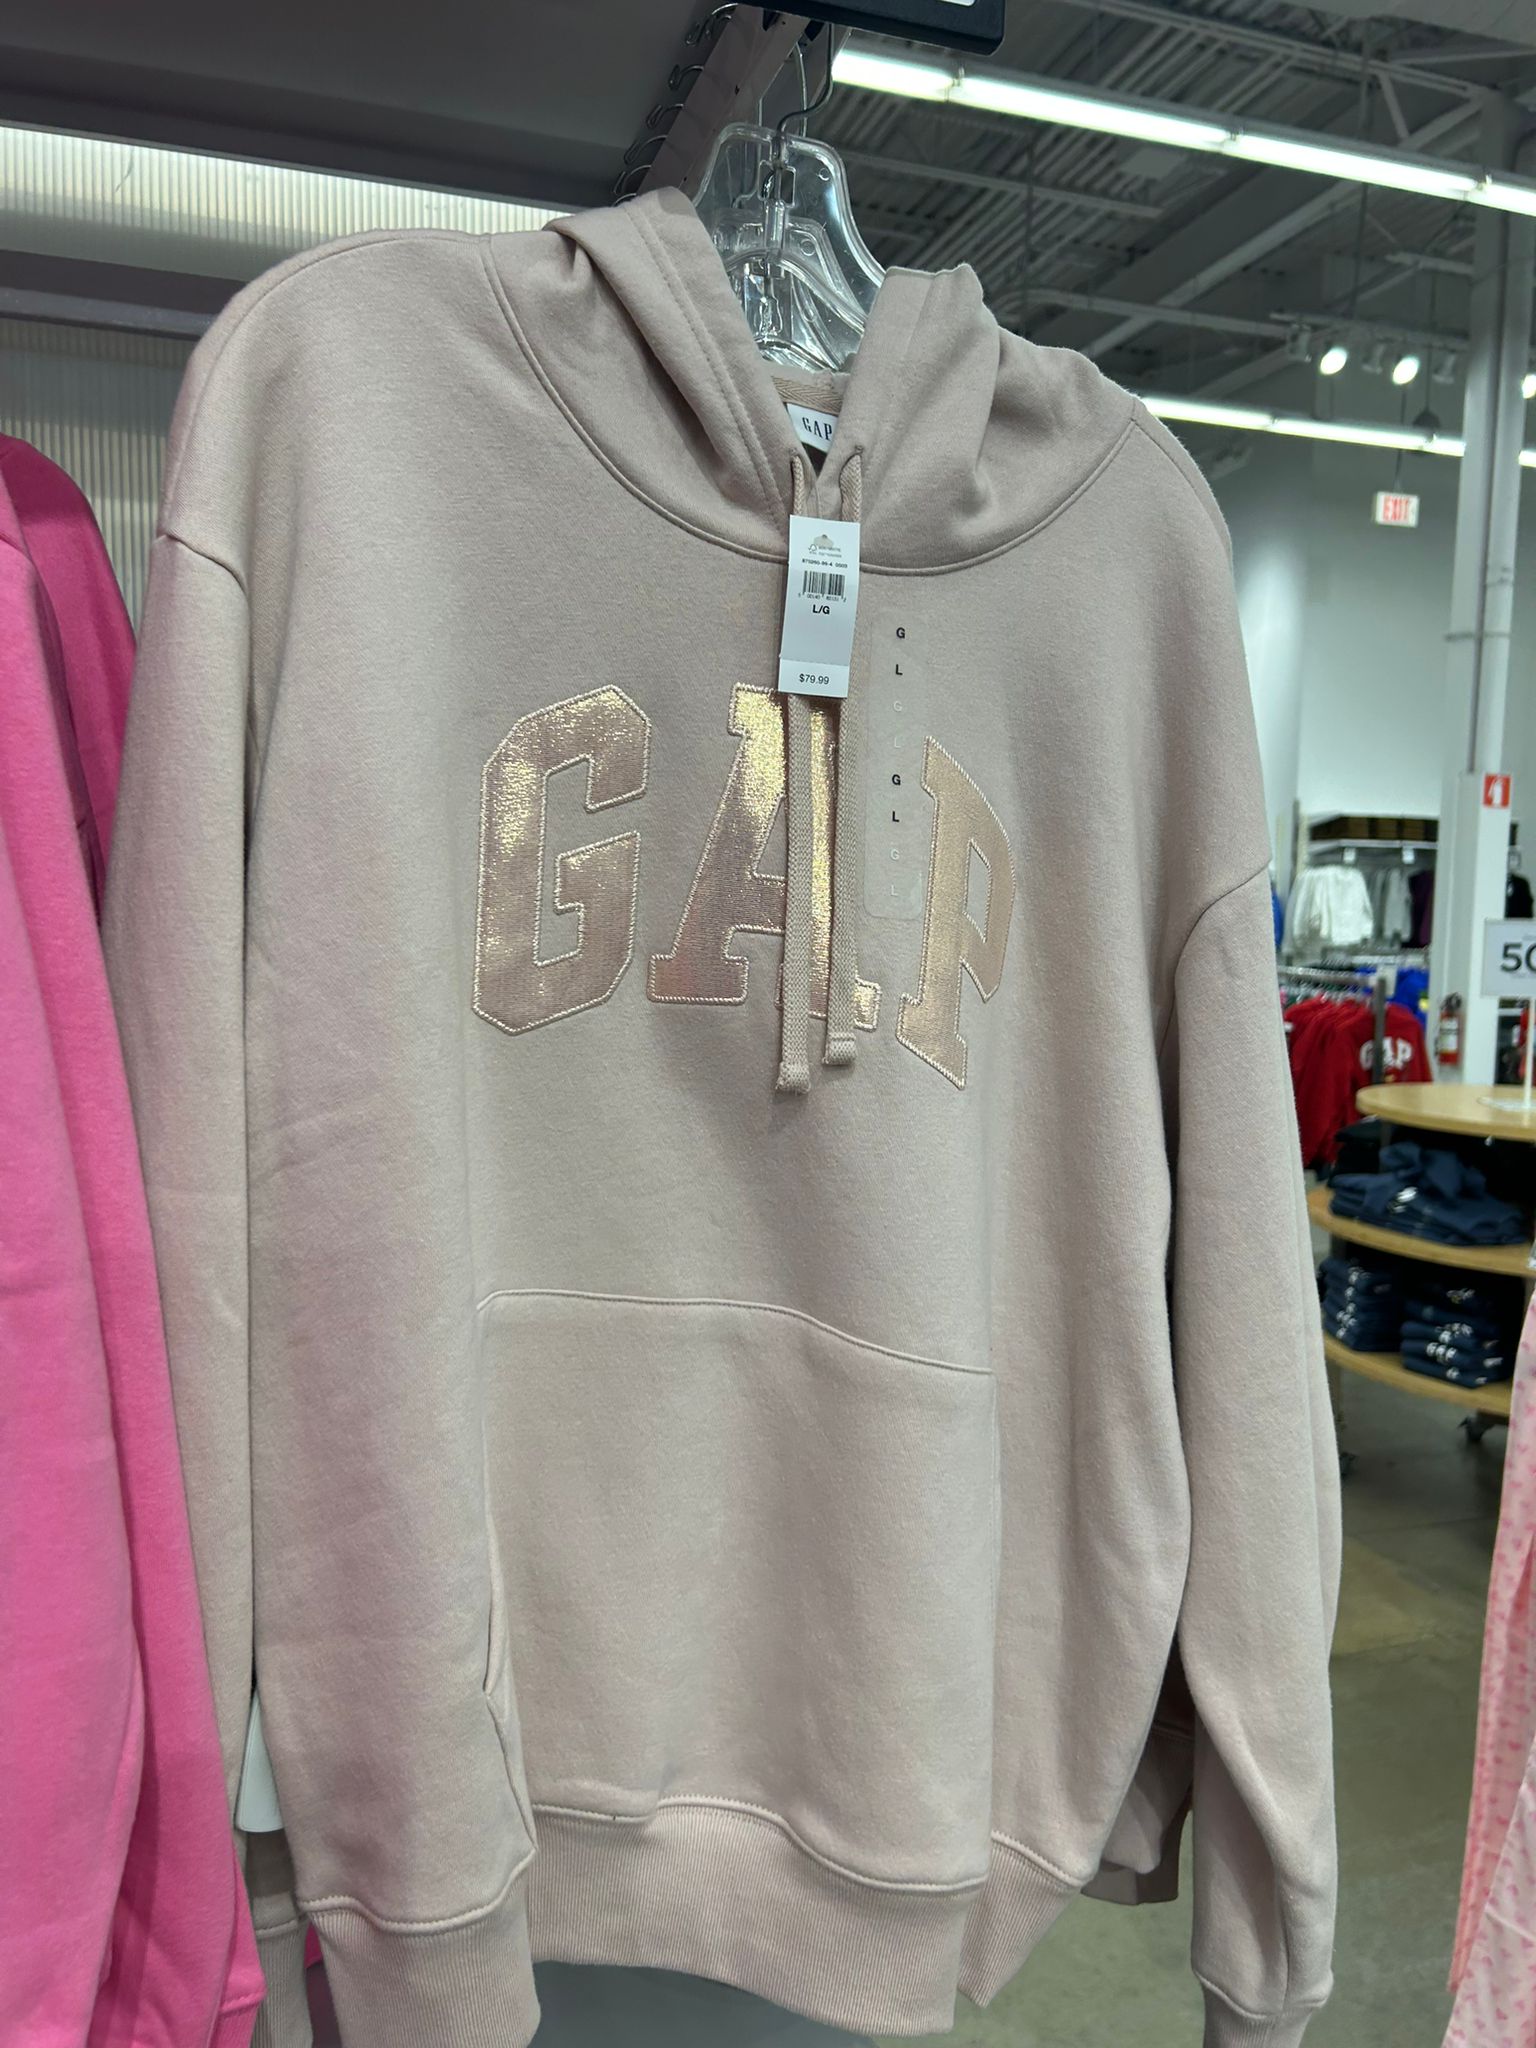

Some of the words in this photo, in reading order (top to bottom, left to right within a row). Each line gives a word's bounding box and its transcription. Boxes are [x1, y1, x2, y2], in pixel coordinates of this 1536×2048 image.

[802, 417, 833, 440] GAP
[812, 604, 830, 615] L/G
[895, 627, 906, 639] G
[895, 664, 903, 676] L
[799, 673, 830, 686] $79.99
[891, 774, 902, 786] G
[891, 811, 900, 823] L
[472, 682, 1016, 1090] GAP
